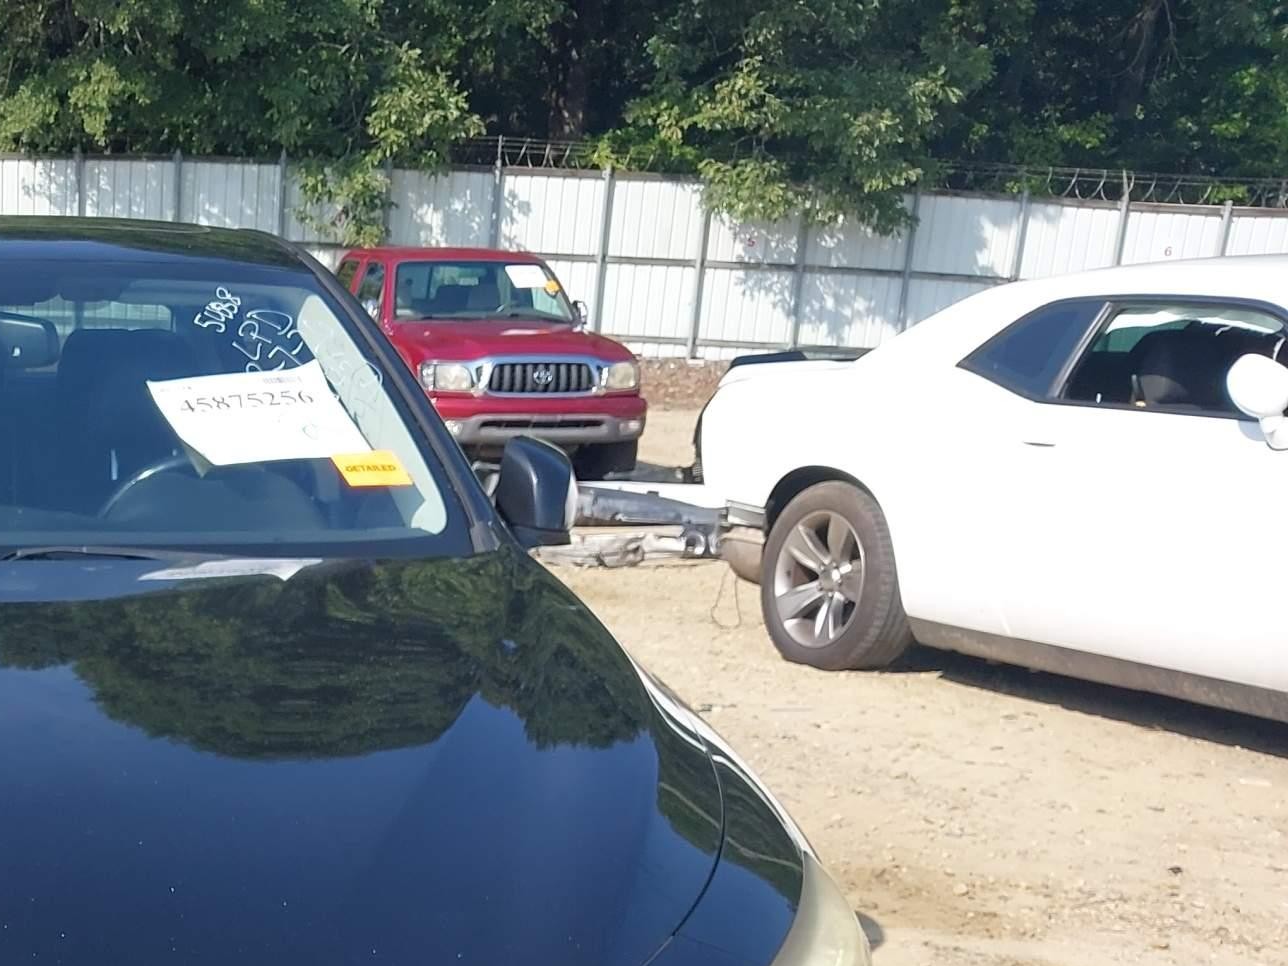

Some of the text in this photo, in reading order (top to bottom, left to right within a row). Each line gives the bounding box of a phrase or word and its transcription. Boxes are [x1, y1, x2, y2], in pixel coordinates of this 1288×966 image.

[1163, 246, 1173, 257] 6
[179, 389, 314, 413] 45875256
[344, 463, 397, 473] DETAILED
